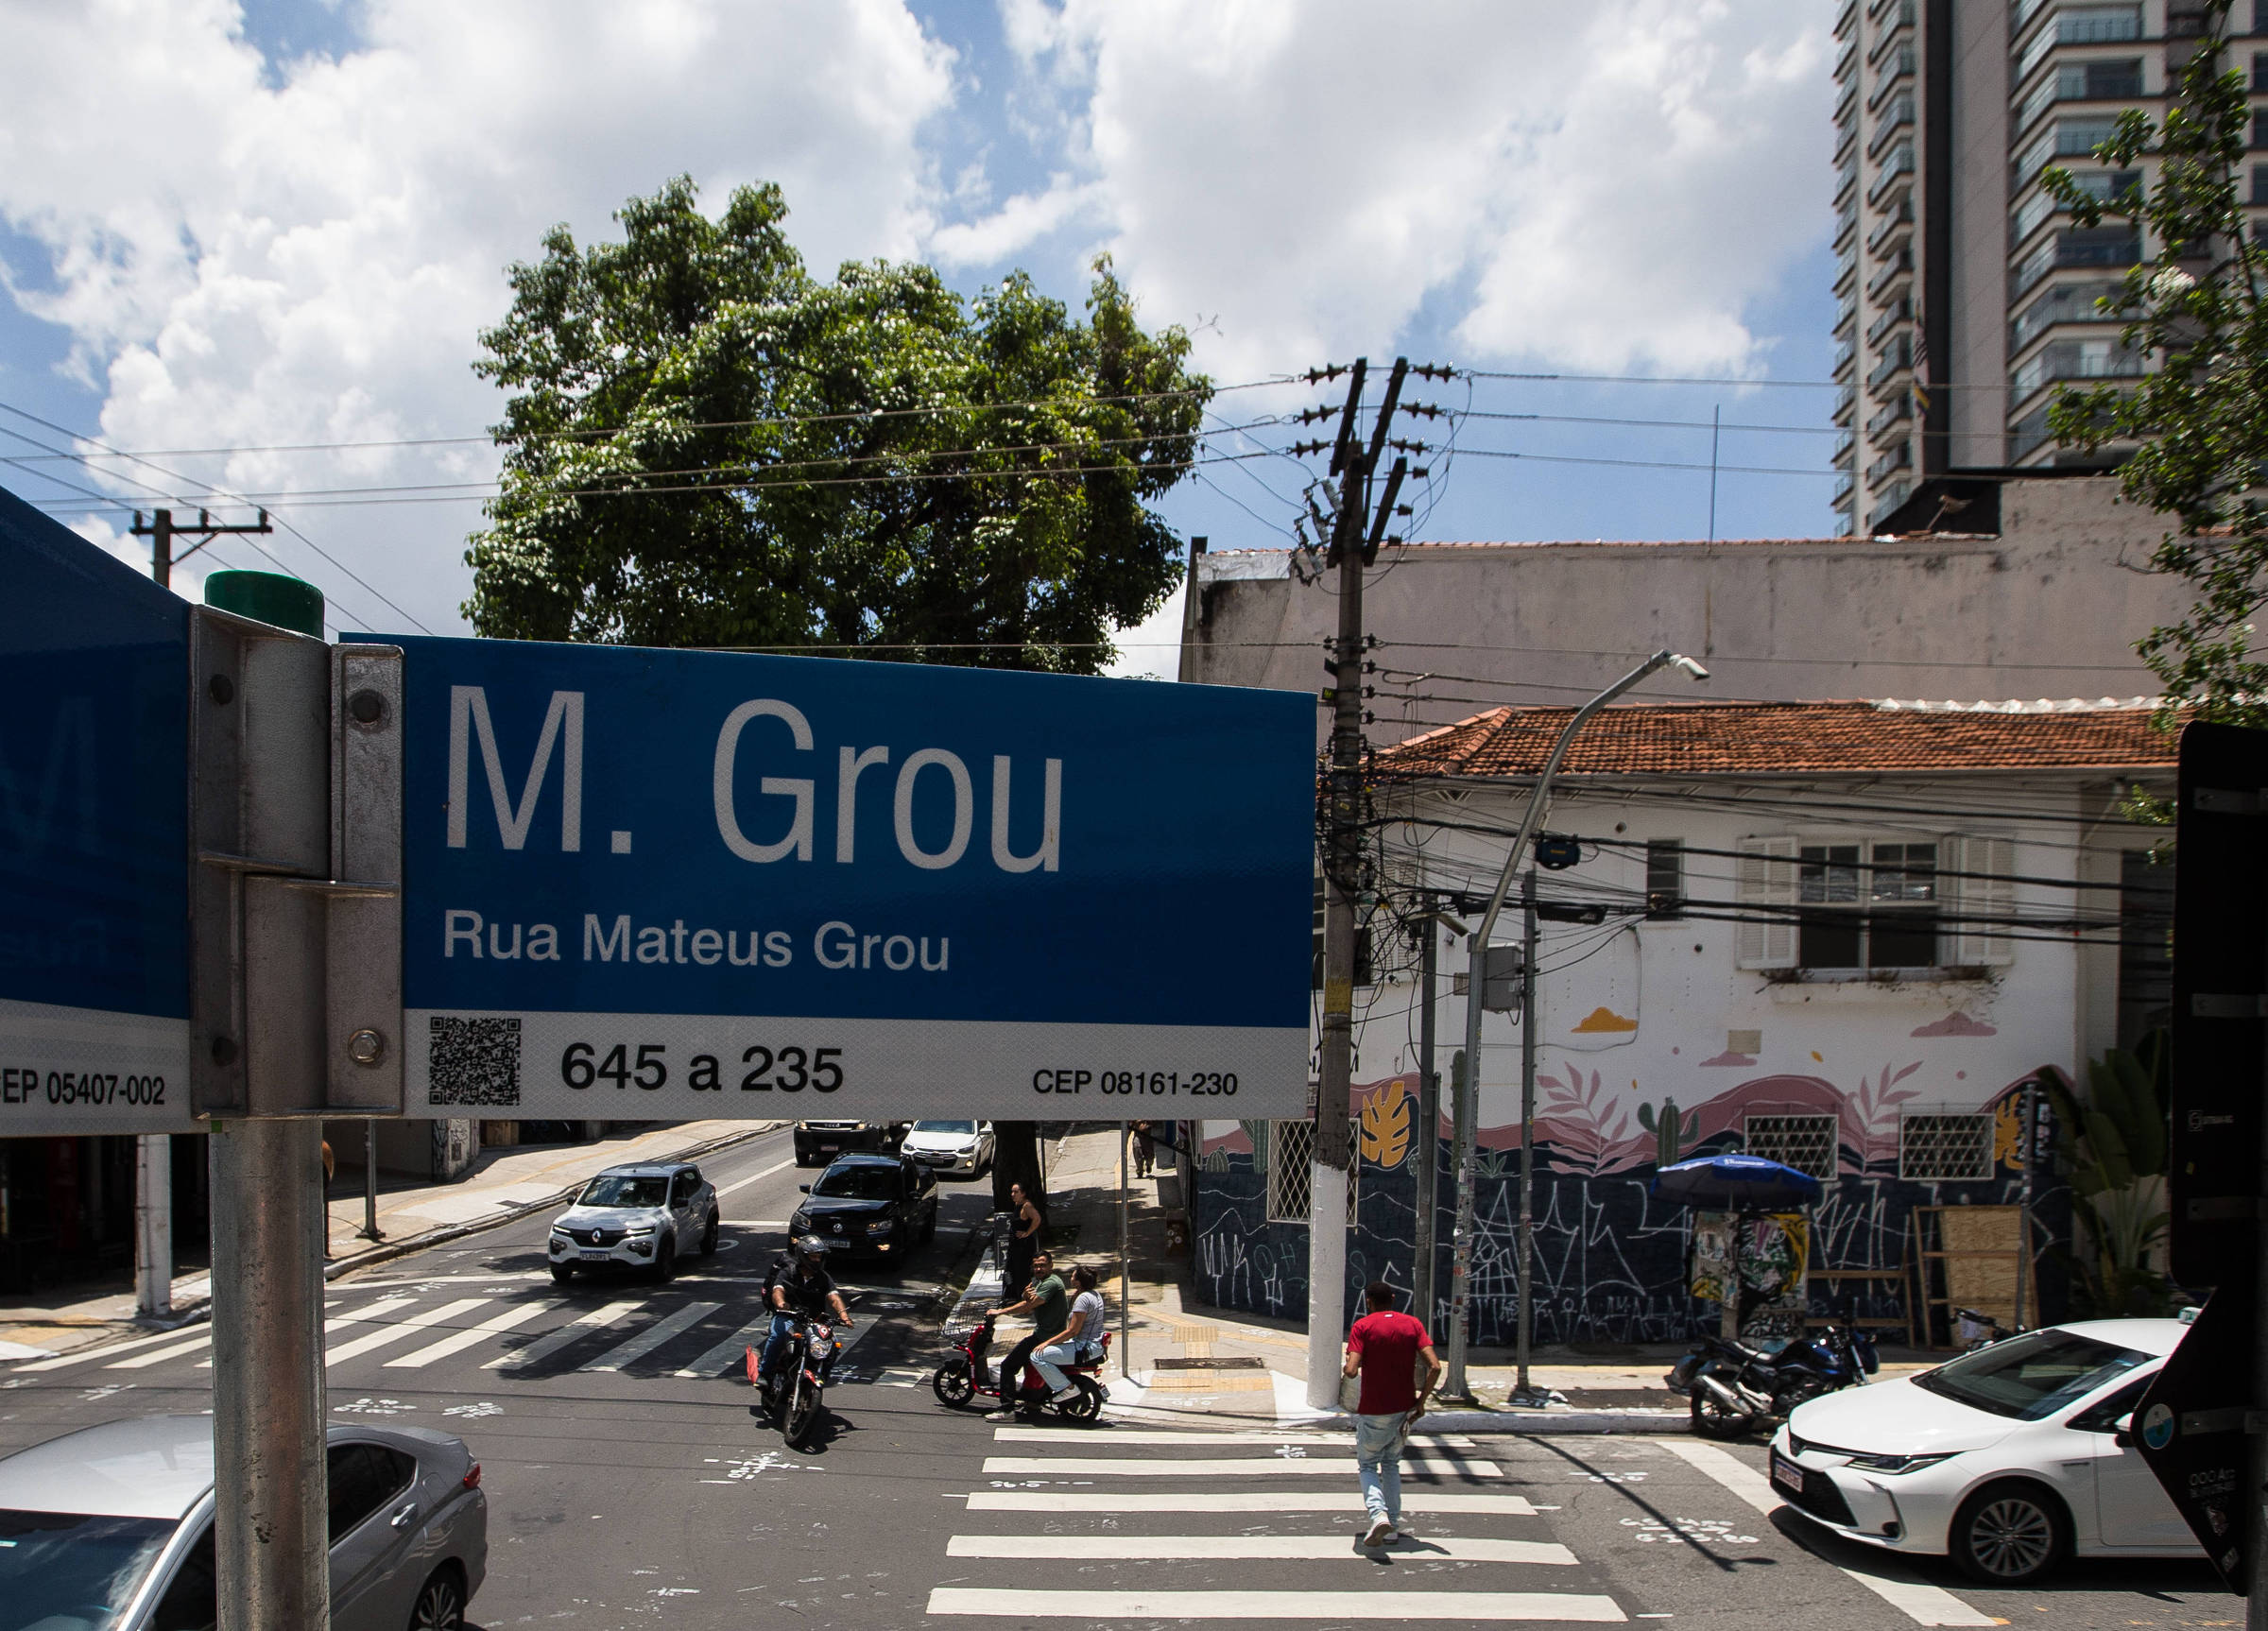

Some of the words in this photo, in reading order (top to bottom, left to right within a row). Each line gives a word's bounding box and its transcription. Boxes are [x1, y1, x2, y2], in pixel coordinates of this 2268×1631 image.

[448, 685, 631, 854] M.
[713, 698, 1062, 873] Grou
[445, 909, 560, 961] Rua
[584, 914, 792, 967] Mateus
[815, 920, 949, 971] Grou
[0, 1069, 39, 1104] EP
[46, 1072, 165, 1106] 05407-002
[561, 1042, 667, 1091] 645
[689, 1054, 723, 1091] a
[740, 1045, 844, 1093] 235
[1032, 1069, 1092, 1094] CEP
[1101, 1071, 1239, 1096] 08161-230
